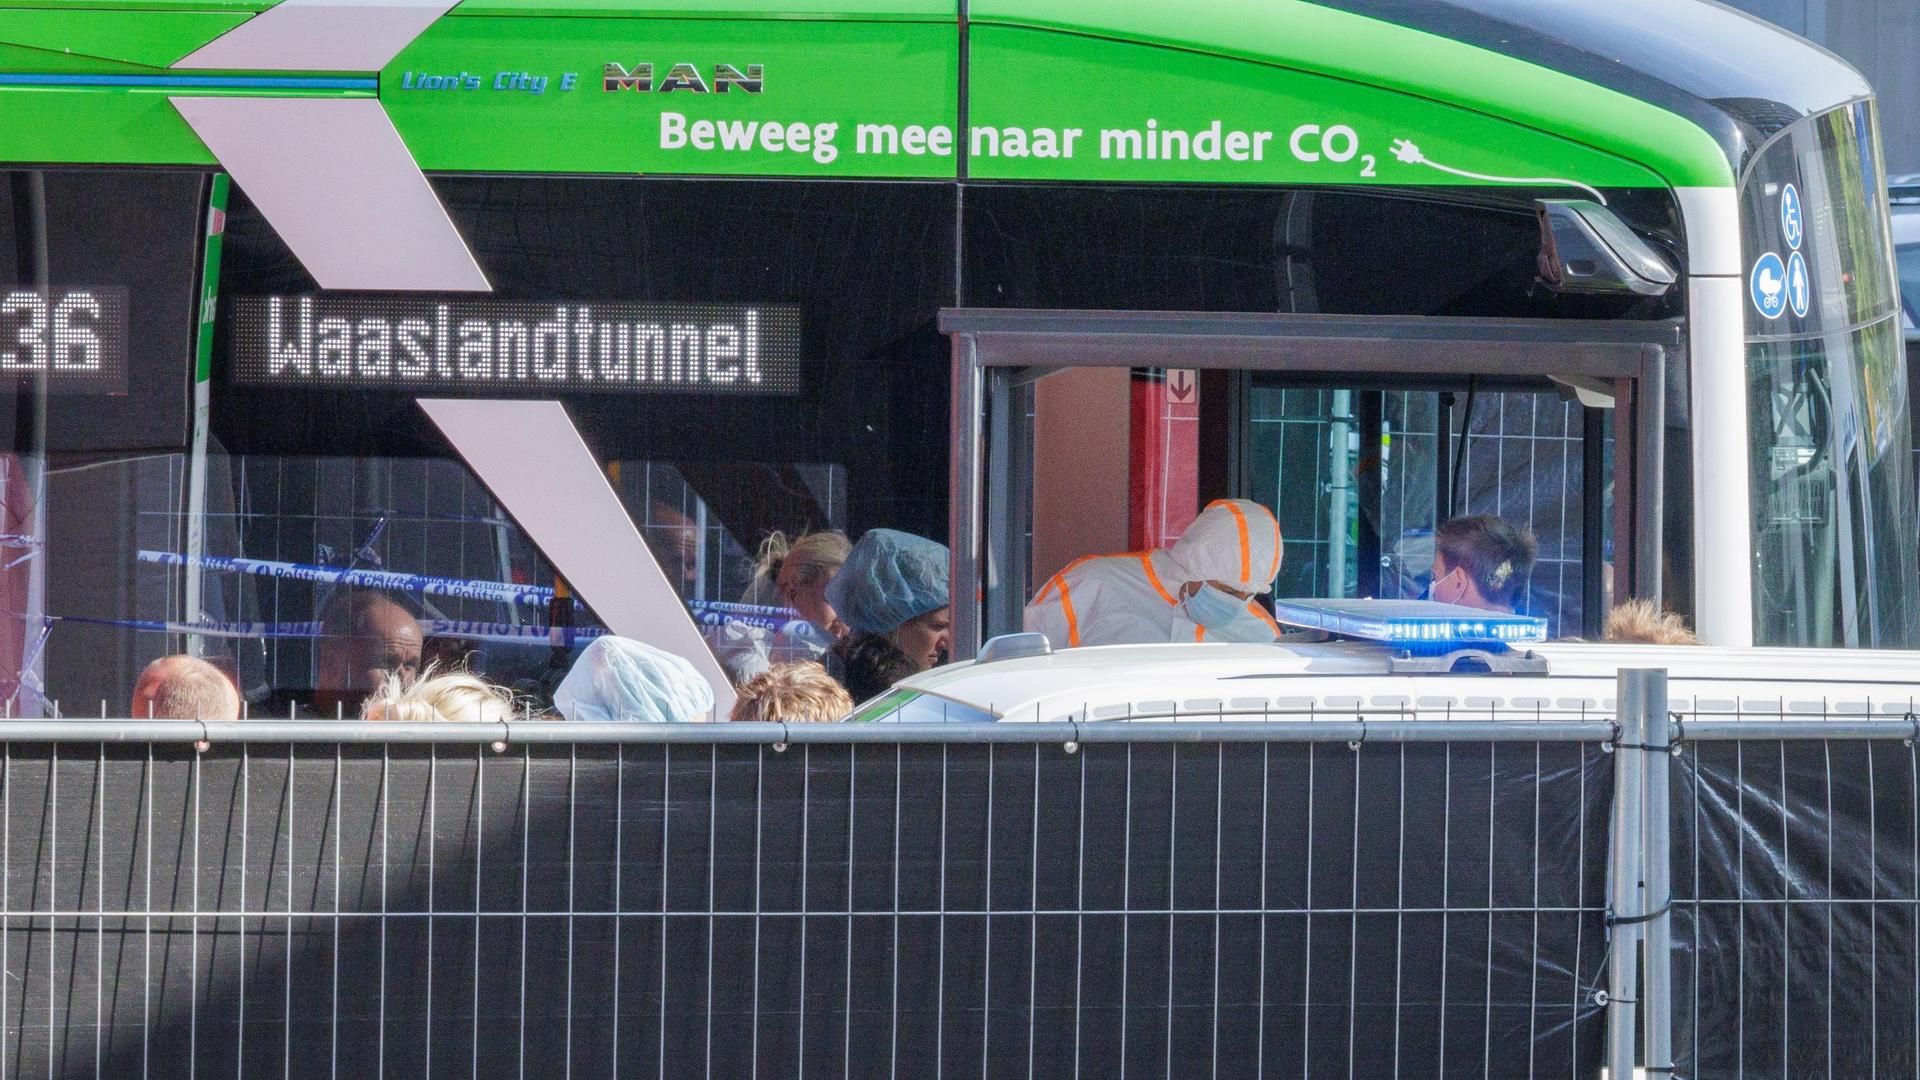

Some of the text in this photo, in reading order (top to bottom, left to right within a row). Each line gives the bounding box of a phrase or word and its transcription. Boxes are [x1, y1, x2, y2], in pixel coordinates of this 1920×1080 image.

[401, 71, 579, 95] Lion's City E
[603, 62, 764, 94] MAN
[659, 111, 839, 164] Beweeg
[856, 123, 953, 156] mee
[970, 126, 1083, 158] naar
[1100, 118, 1273, 161] minder
[1, 292, 100, 370] 36
[269, 297, 762, 385] Waaslandtunnel
